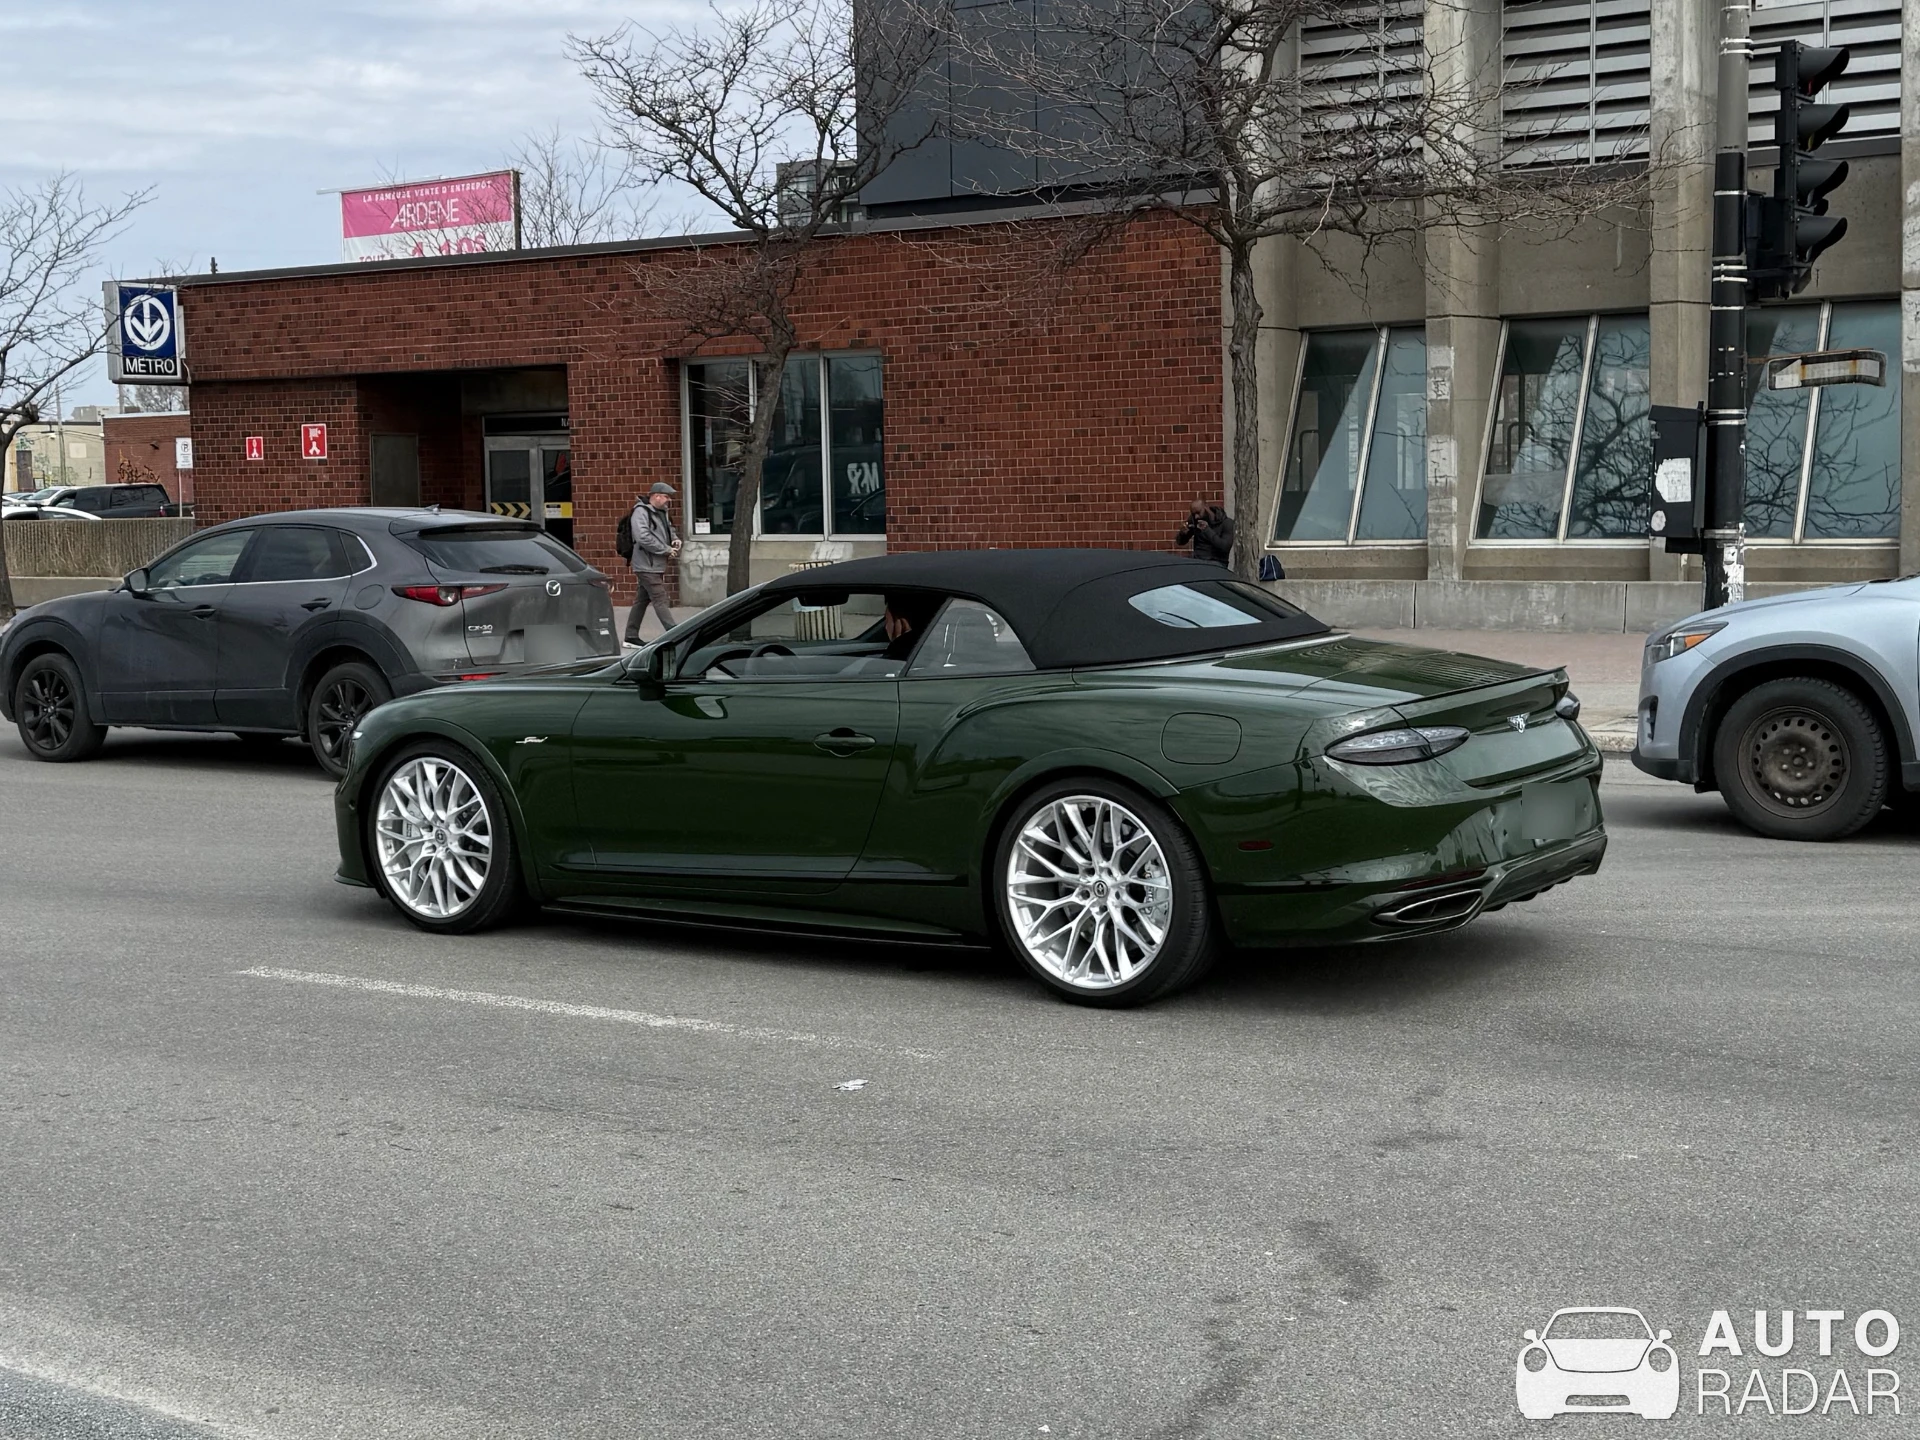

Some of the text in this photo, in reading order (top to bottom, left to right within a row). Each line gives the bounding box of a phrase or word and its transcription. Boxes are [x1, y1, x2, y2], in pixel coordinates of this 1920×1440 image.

[363, 194, 373, 203] LA
[414, 186, 440, 197] VENTE
[390, 198, 460, 229] ARDENE
